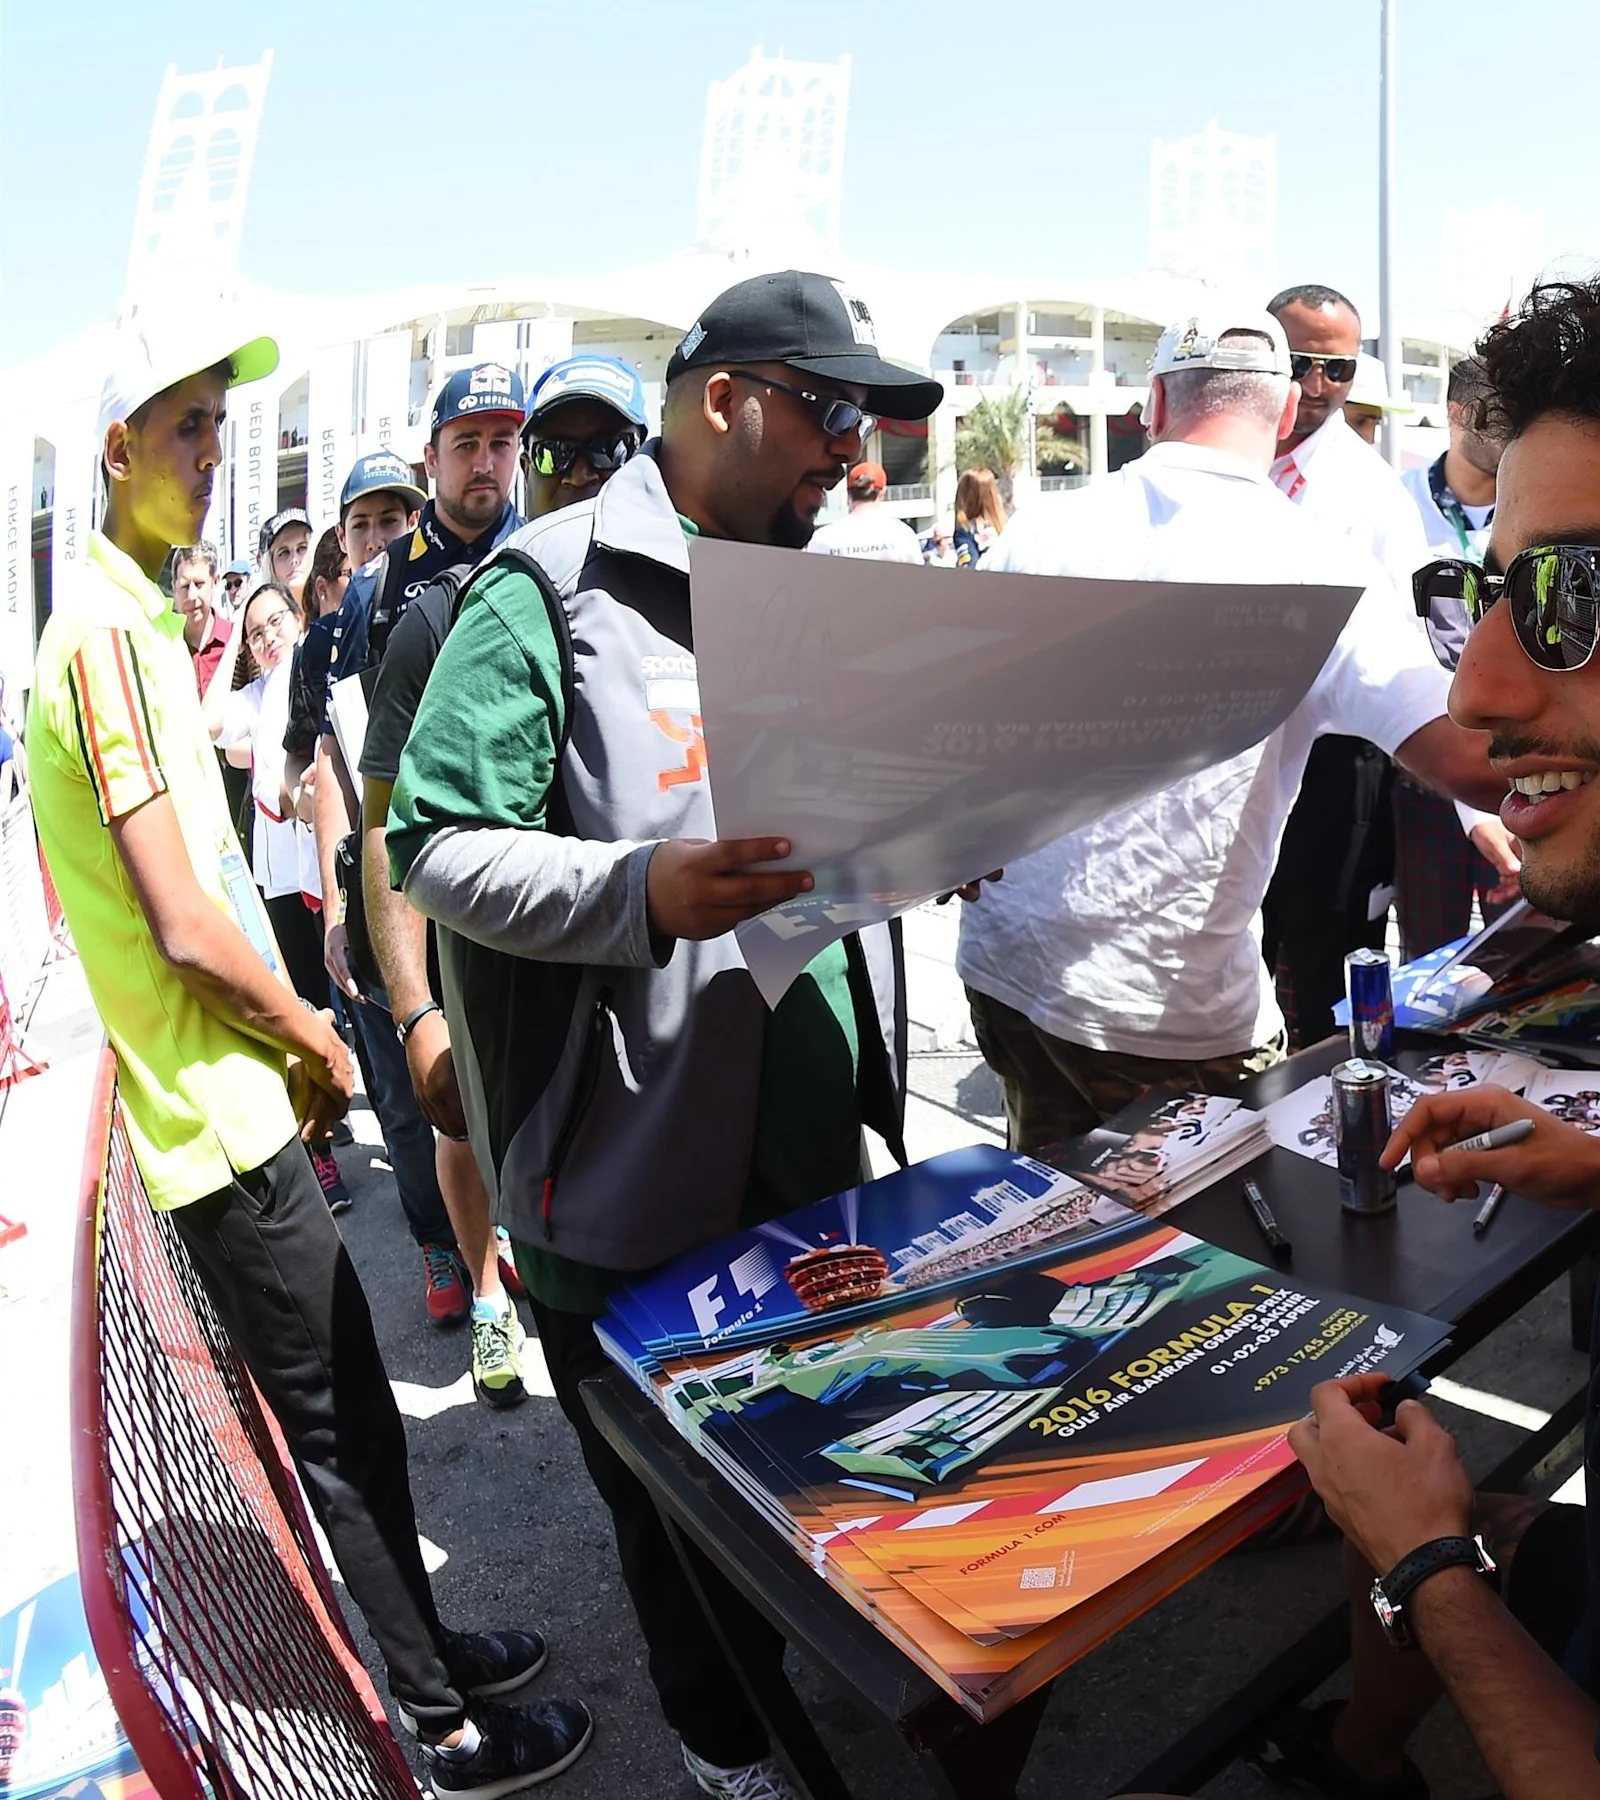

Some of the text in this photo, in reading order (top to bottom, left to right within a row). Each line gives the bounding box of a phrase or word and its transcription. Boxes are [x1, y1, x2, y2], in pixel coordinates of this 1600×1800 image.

[687, 1241, 780, 1339] F1
[1251, 1292, 1307, 1333] SAKHIR
[703, 1310, 754, 1349] Formula
[1029, 1284, 1275, 1436] 2016 FORMULA 1
[1058, 1288, 1293, 1438] GULF AIR BAHRAIN GRAND PRIX
[1210, 1298, 1321, 1375] 01-02-03 APRIL
[1254, 1311, 1359, 1393] +973 1745 0000
[1354, 1348, 1389, 1375] ulf Air
[960, 1540, 1023, 1575] FORMULA
[1023, 1513, 1067, 1540] 1.COM
